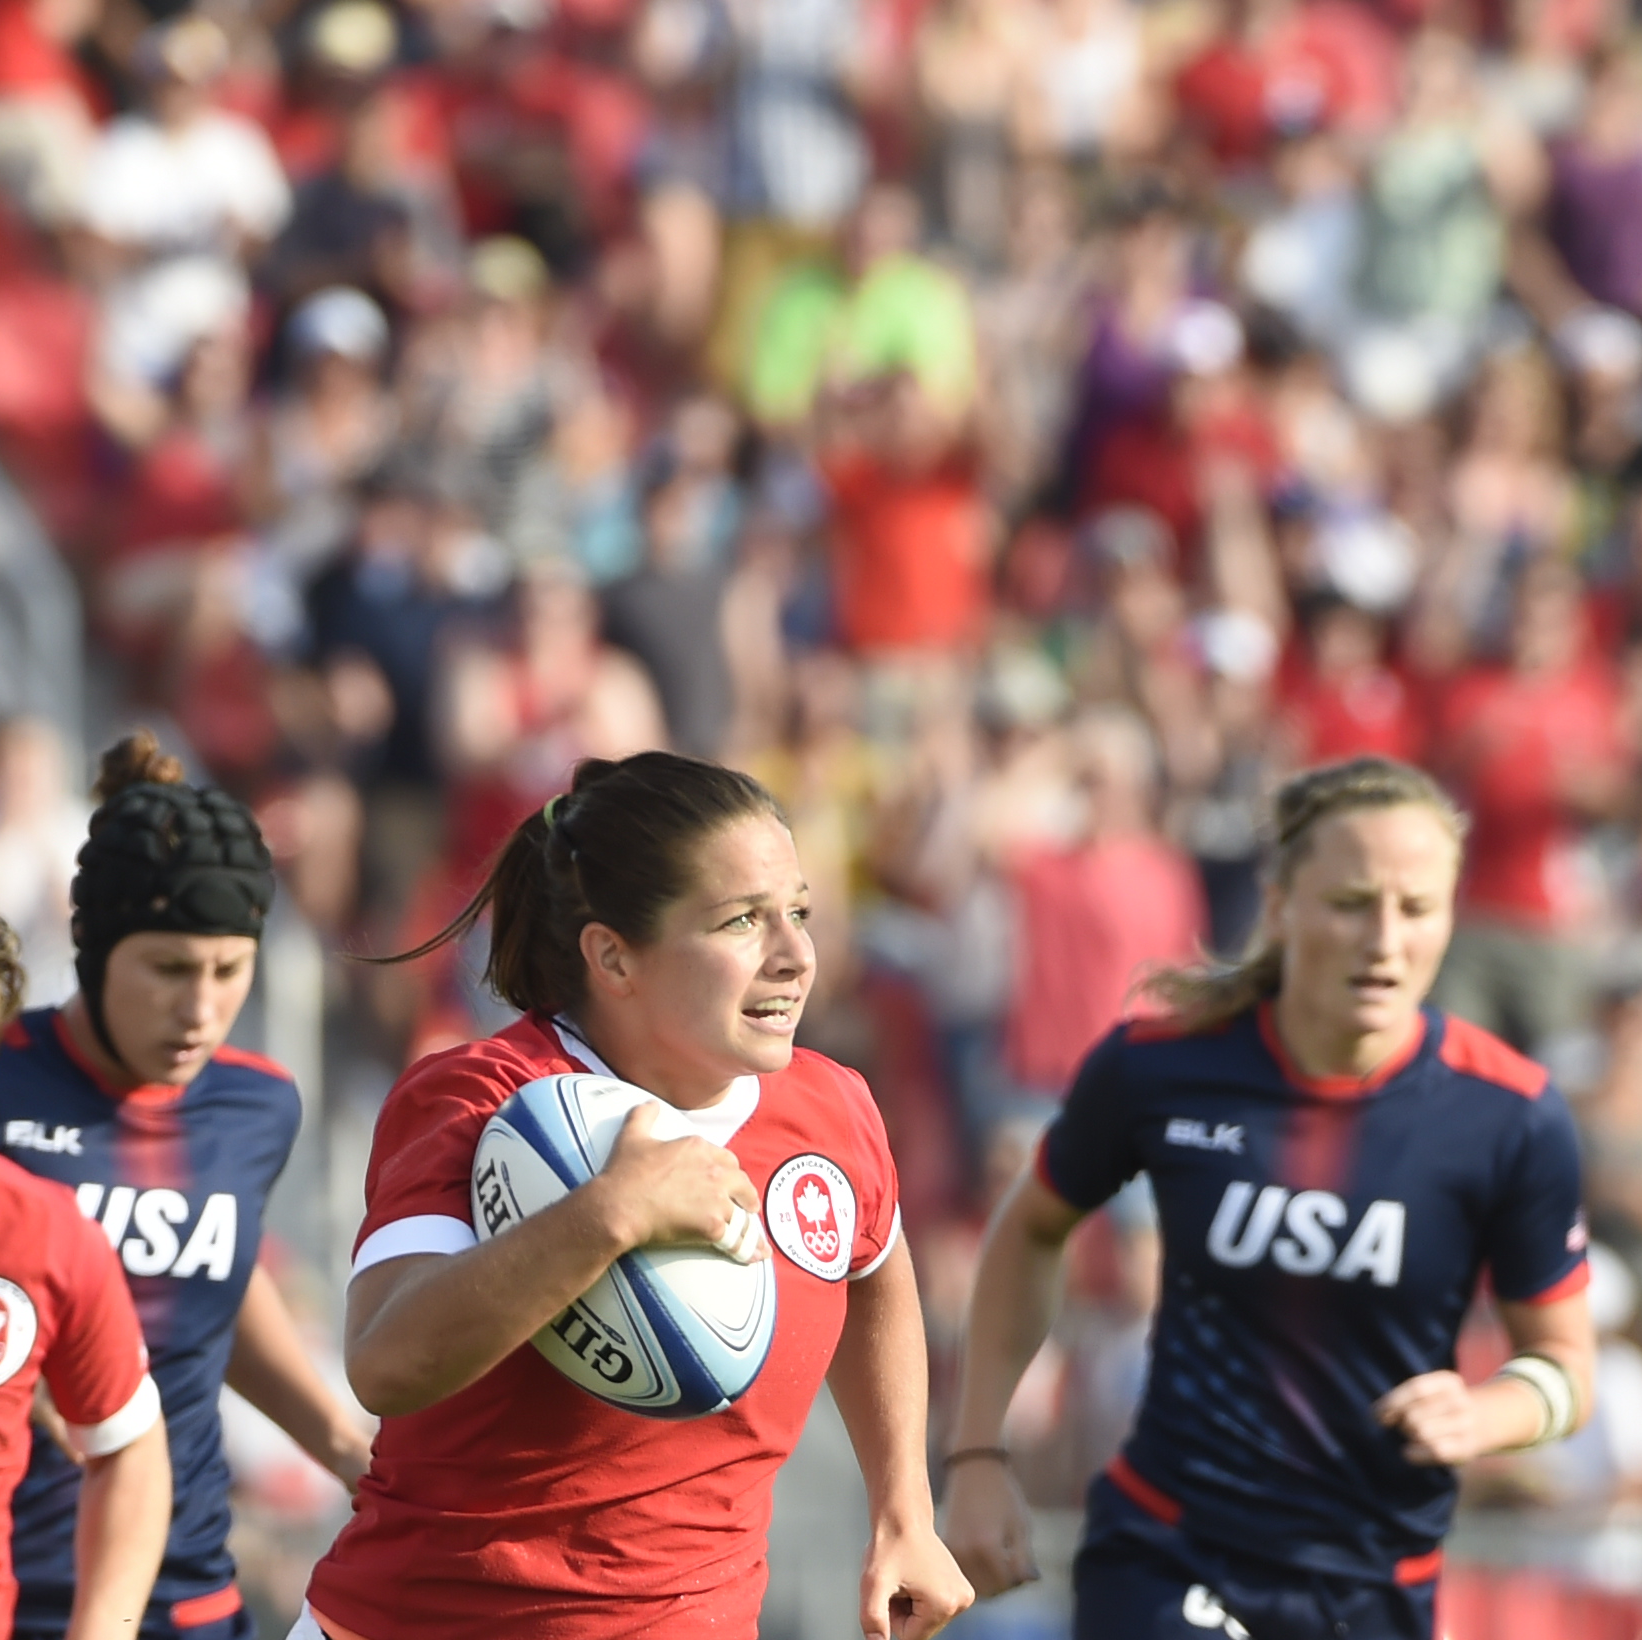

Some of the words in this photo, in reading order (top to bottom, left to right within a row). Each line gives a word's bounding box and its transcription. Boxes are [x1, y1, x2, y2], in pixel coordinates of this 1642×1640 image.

[5, 1120, 83, 1156] BLK
[1165, 1118, 1245, 1155] BLK
[1207, 1181, 1406, 1287] USA
